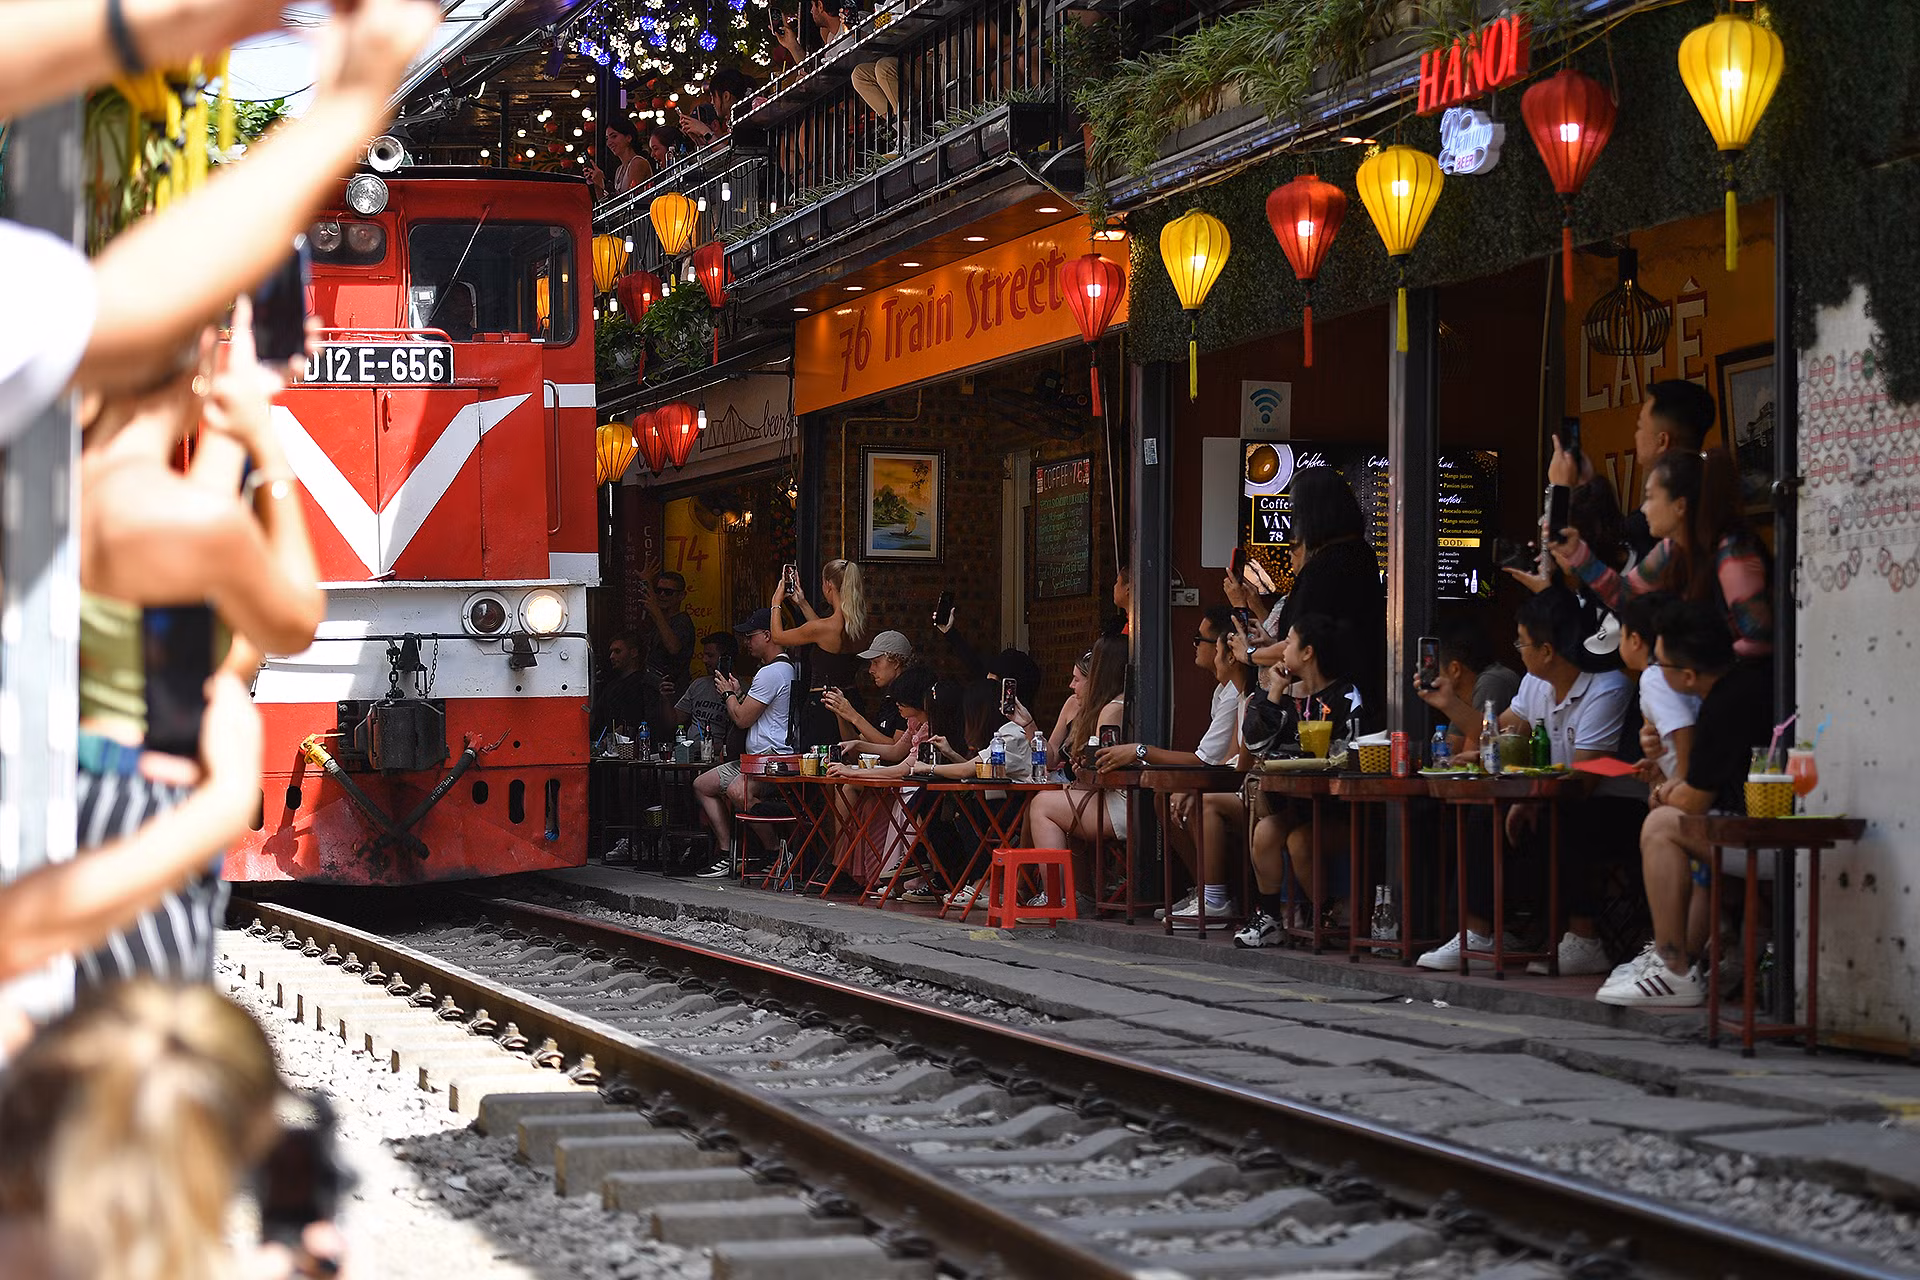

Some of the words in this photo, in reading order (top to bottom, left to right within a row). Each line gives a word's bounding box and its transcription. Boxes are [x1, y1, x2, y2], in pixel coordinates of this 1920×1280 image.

[1416, 14, 1521, 116] HANOI
[1456, 154, 1475, 170] BEER
[839, 306, 872, 392] 76
[881, 284, 954, 362] Train
[964, 246, 1067, 339] Street
[1261, 511, 1292, 529] VÂN
[1268, 531, 1284, 542] 78
[665, 535, 709, 572] 74
